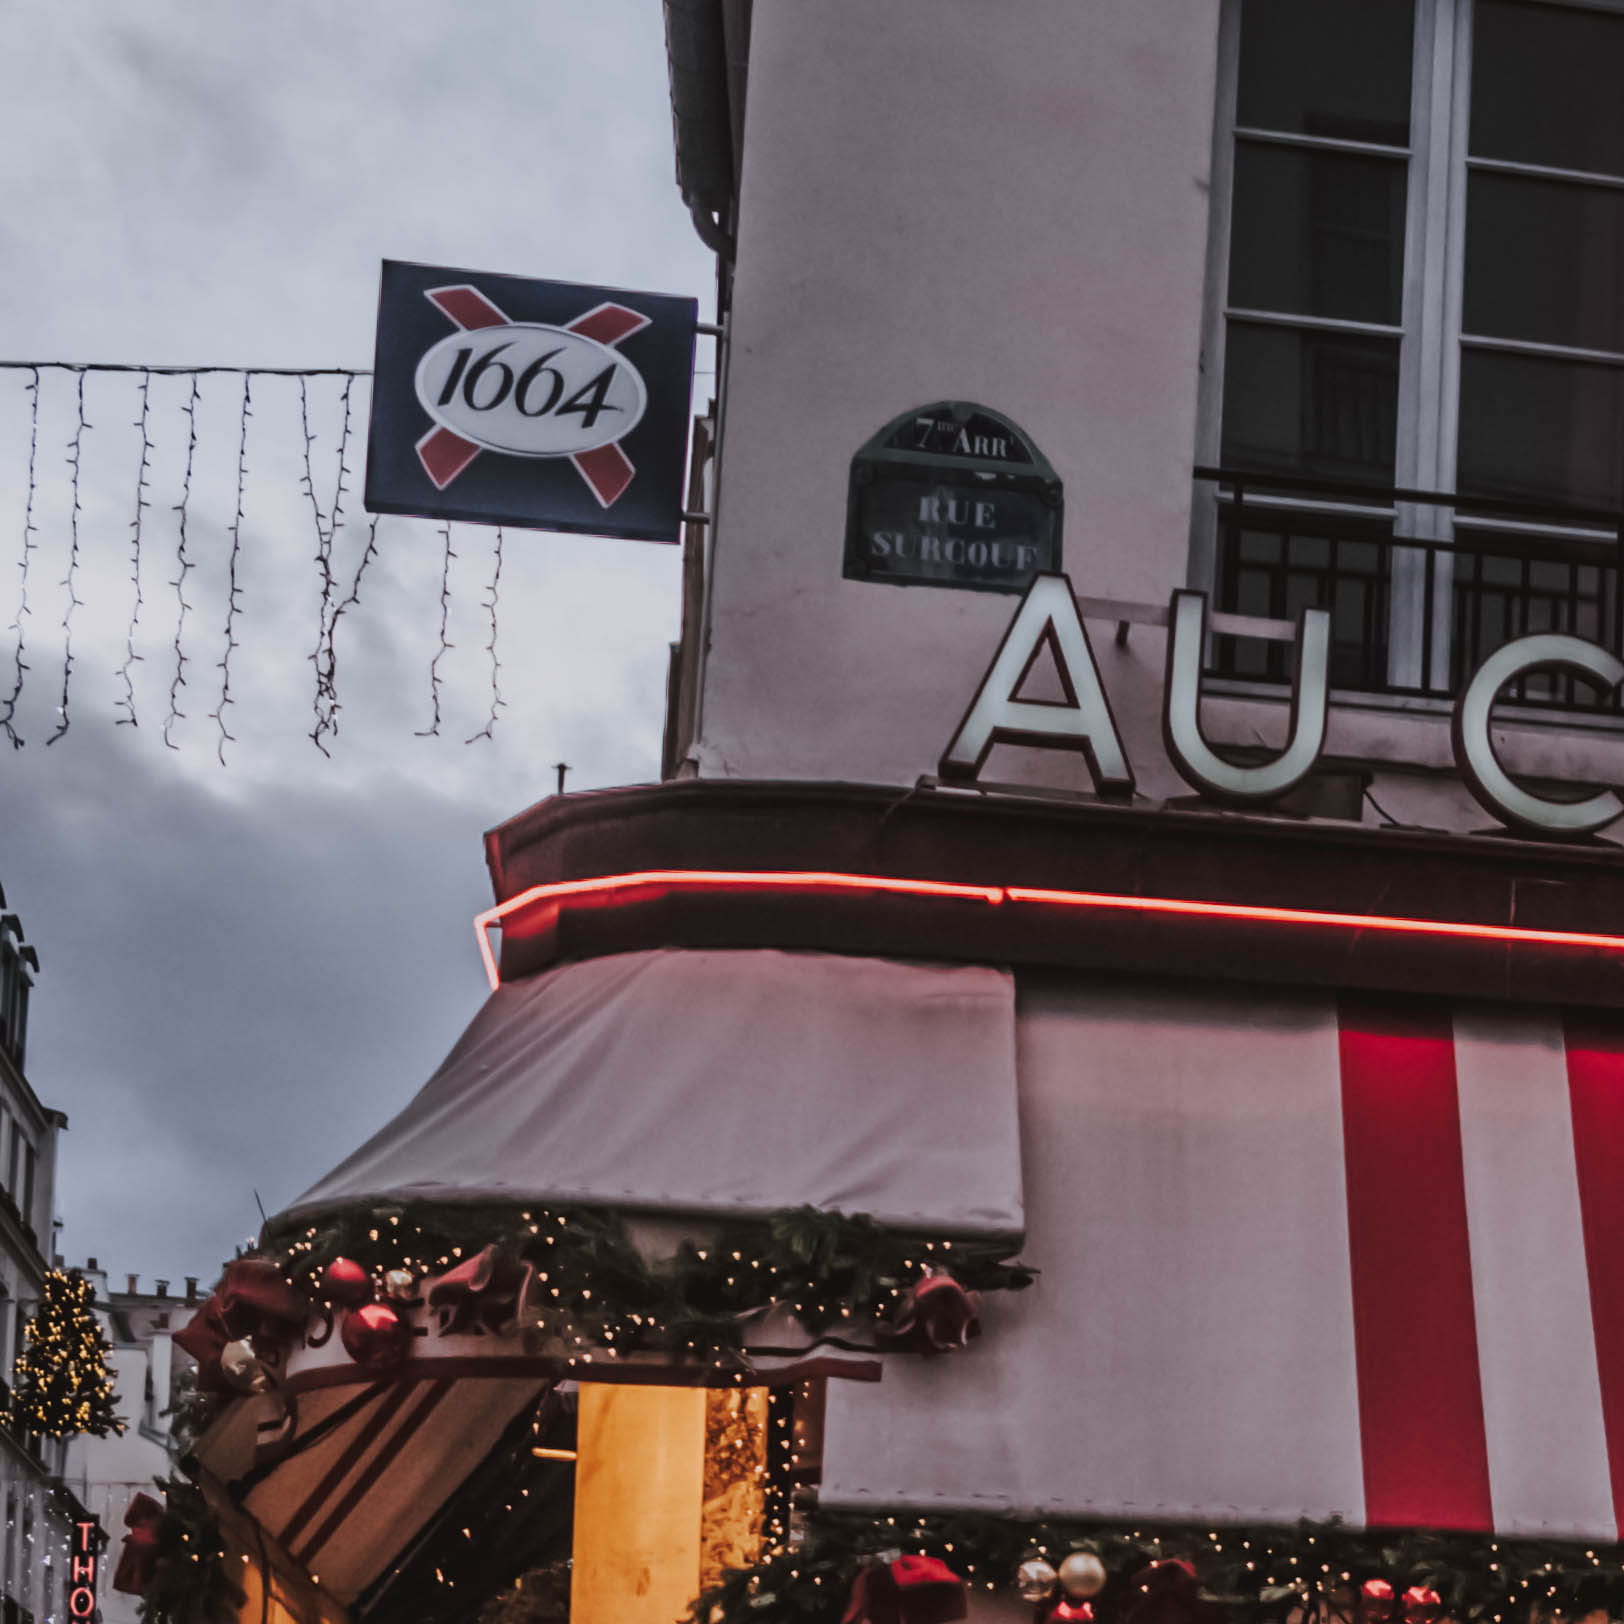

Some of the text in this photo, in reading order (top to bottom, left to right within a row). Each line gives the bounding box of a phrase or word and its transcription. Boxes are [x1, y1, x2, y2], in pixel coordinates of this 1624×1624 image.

[437, 341, 624, 429] 1664
[919, 495, 996, 529] RUE
[871, 530, 1038, 571] SURCOUF
[938, 572, 1331, 799] AU
